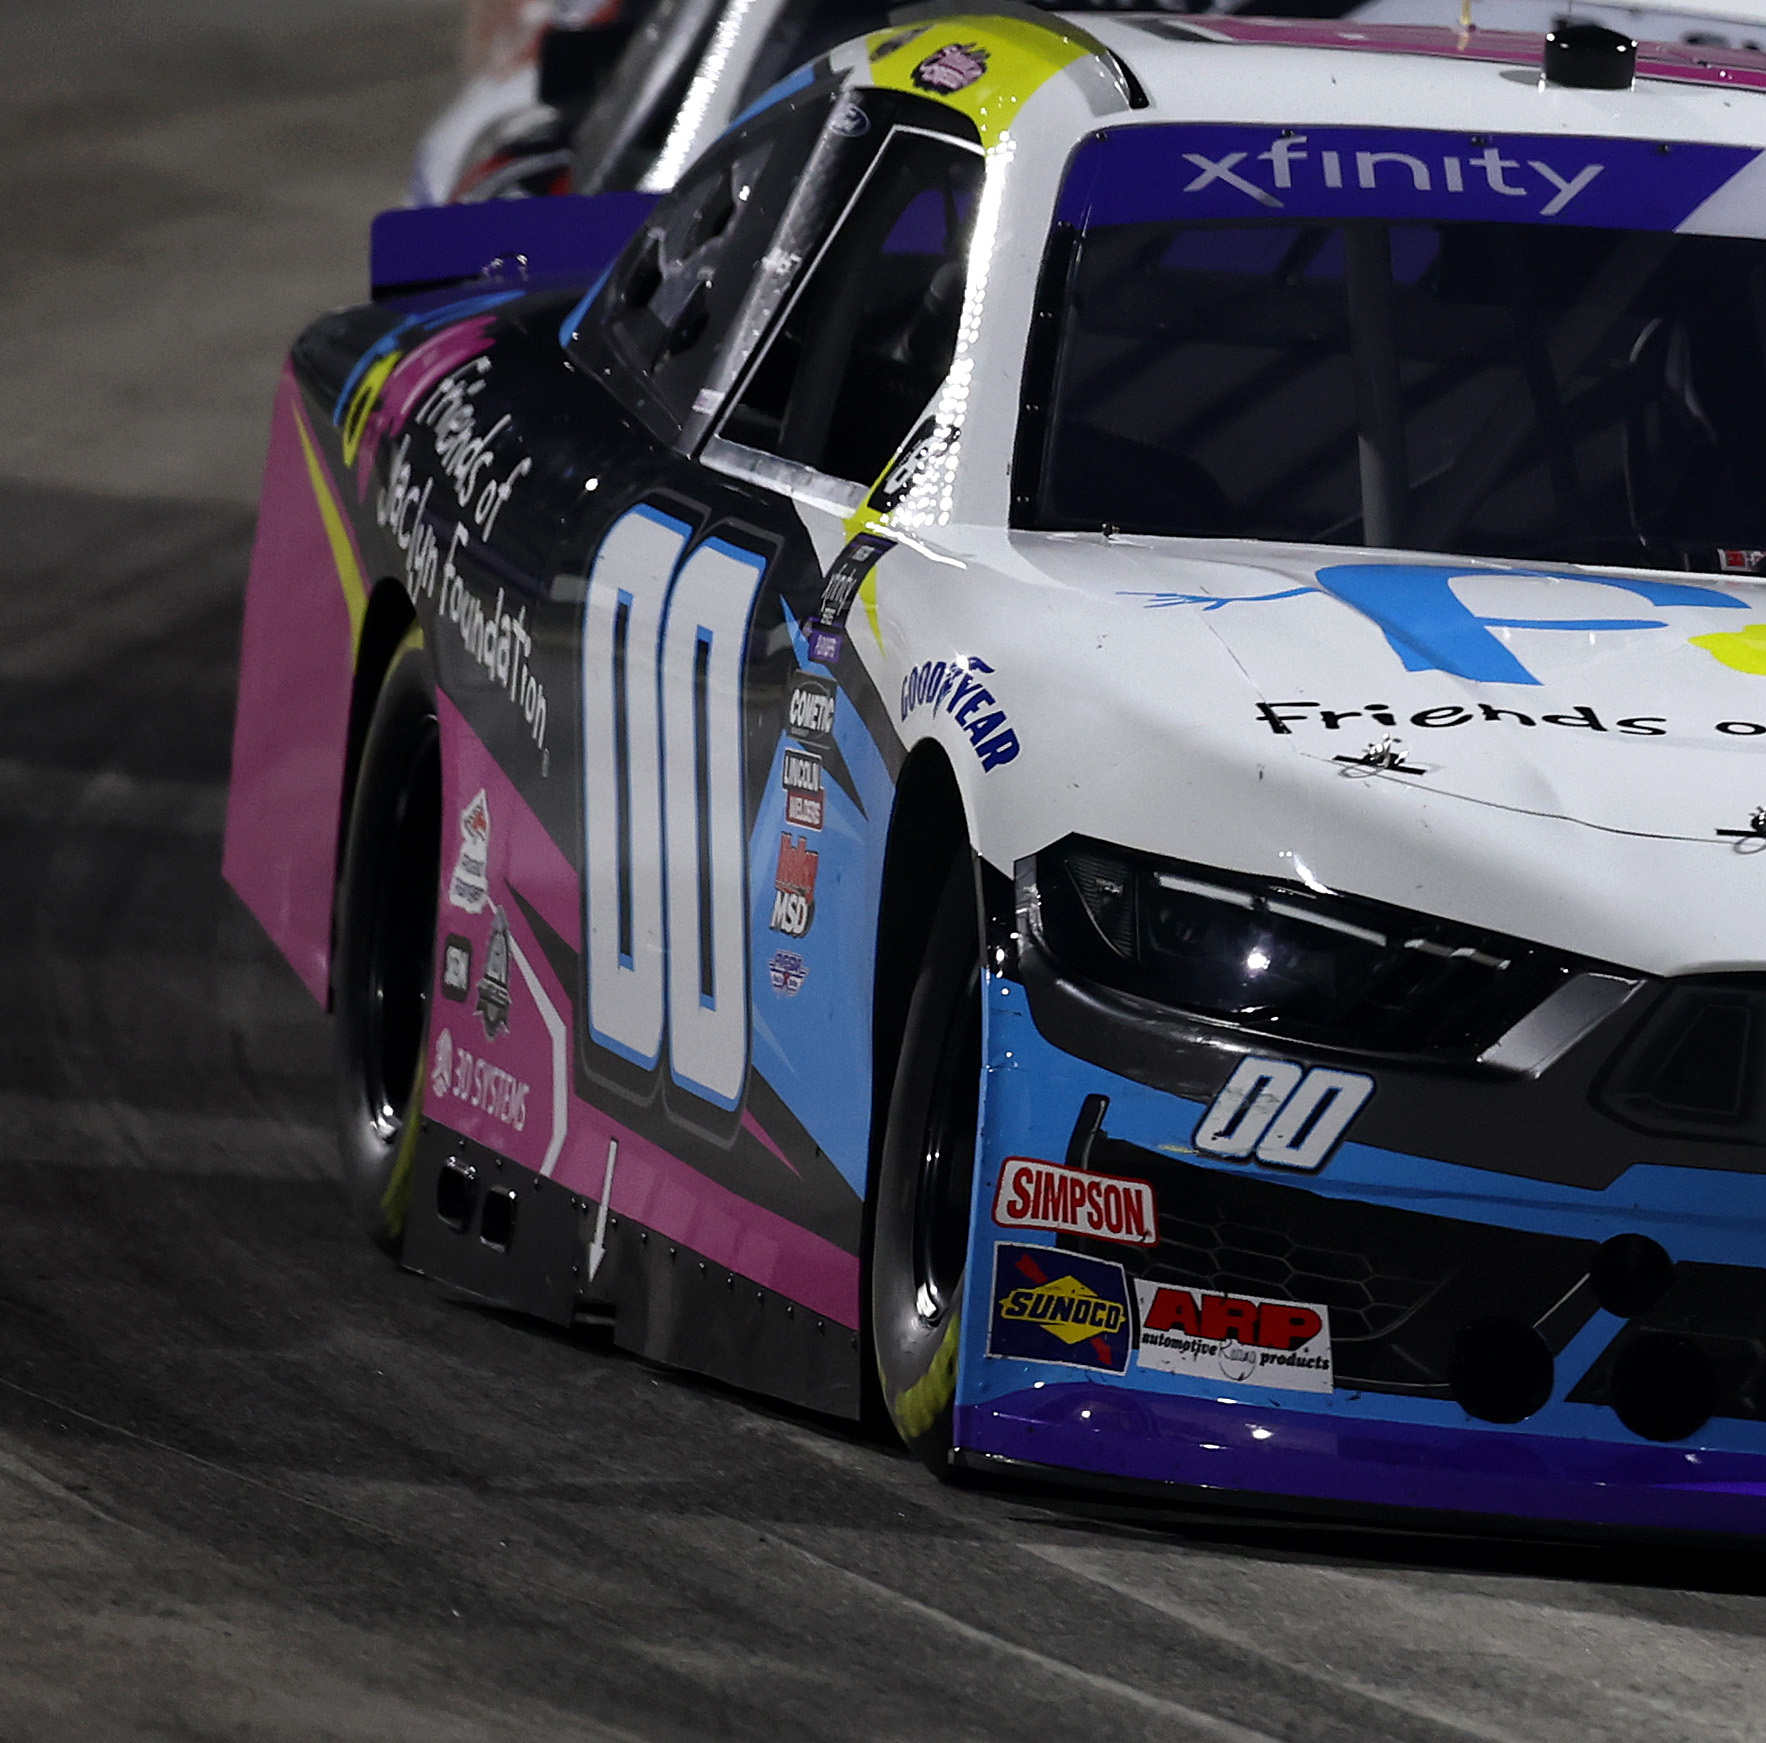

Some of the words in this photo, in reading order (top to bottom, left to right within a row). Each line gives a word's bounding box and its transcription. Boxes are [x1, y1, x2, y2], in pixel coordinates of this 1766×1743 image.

[1183, 136, 1604, 216] xfinity
[416, 355, 494, 507] Friends
[475, 456, 533, 542] of
[376, 433, 440, 605] Jaclyn
[901, 658, 1021, 773] GOODYEAR
[1255, 701, 1667, 737] Friends
[588, 502, 768, 1113] 00
[771, 890, 808, 934] MSD
[1193, 1056, 1376, 1173] 00
[1006, 1167, 1146, 1237] SIMPSON
[1001, 1289, 1123, 1332] SUNOCO
[1143, 1287, 1322, 1352] ARP
[1142, 1332, 1218, 1357] automotive
[1258, 1351, 1331, 1370] products
